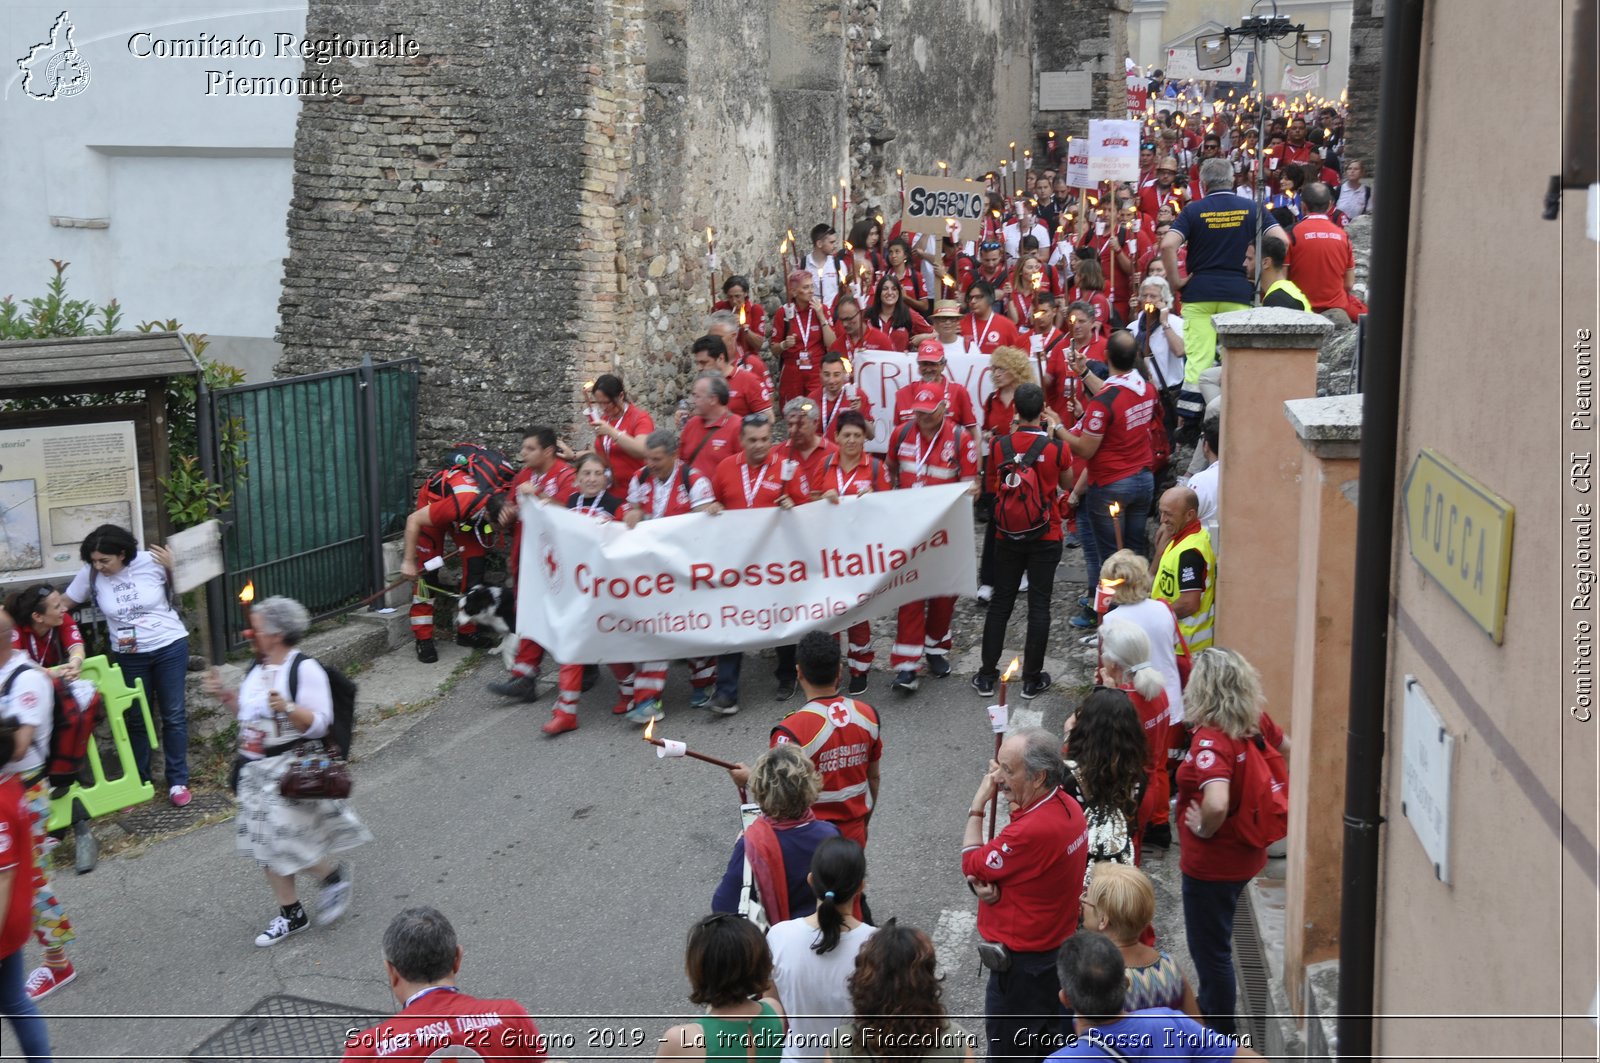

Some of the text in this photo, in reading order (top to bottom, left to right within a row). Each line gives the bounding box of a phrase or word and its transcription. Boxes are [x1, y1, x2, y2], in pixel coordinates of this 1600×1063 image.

[908, 186, 984, 220] SORBOLO
[575, 562, 675, 600] Croce
[690, 559, 808, 591] Rossa
[821, 528, 949, 579] Italiana
[1422, 482, 1486, 596] ROCCA
[596, 611, 712, 635] Comitato
[720, 595, 848, 631] Regionale
